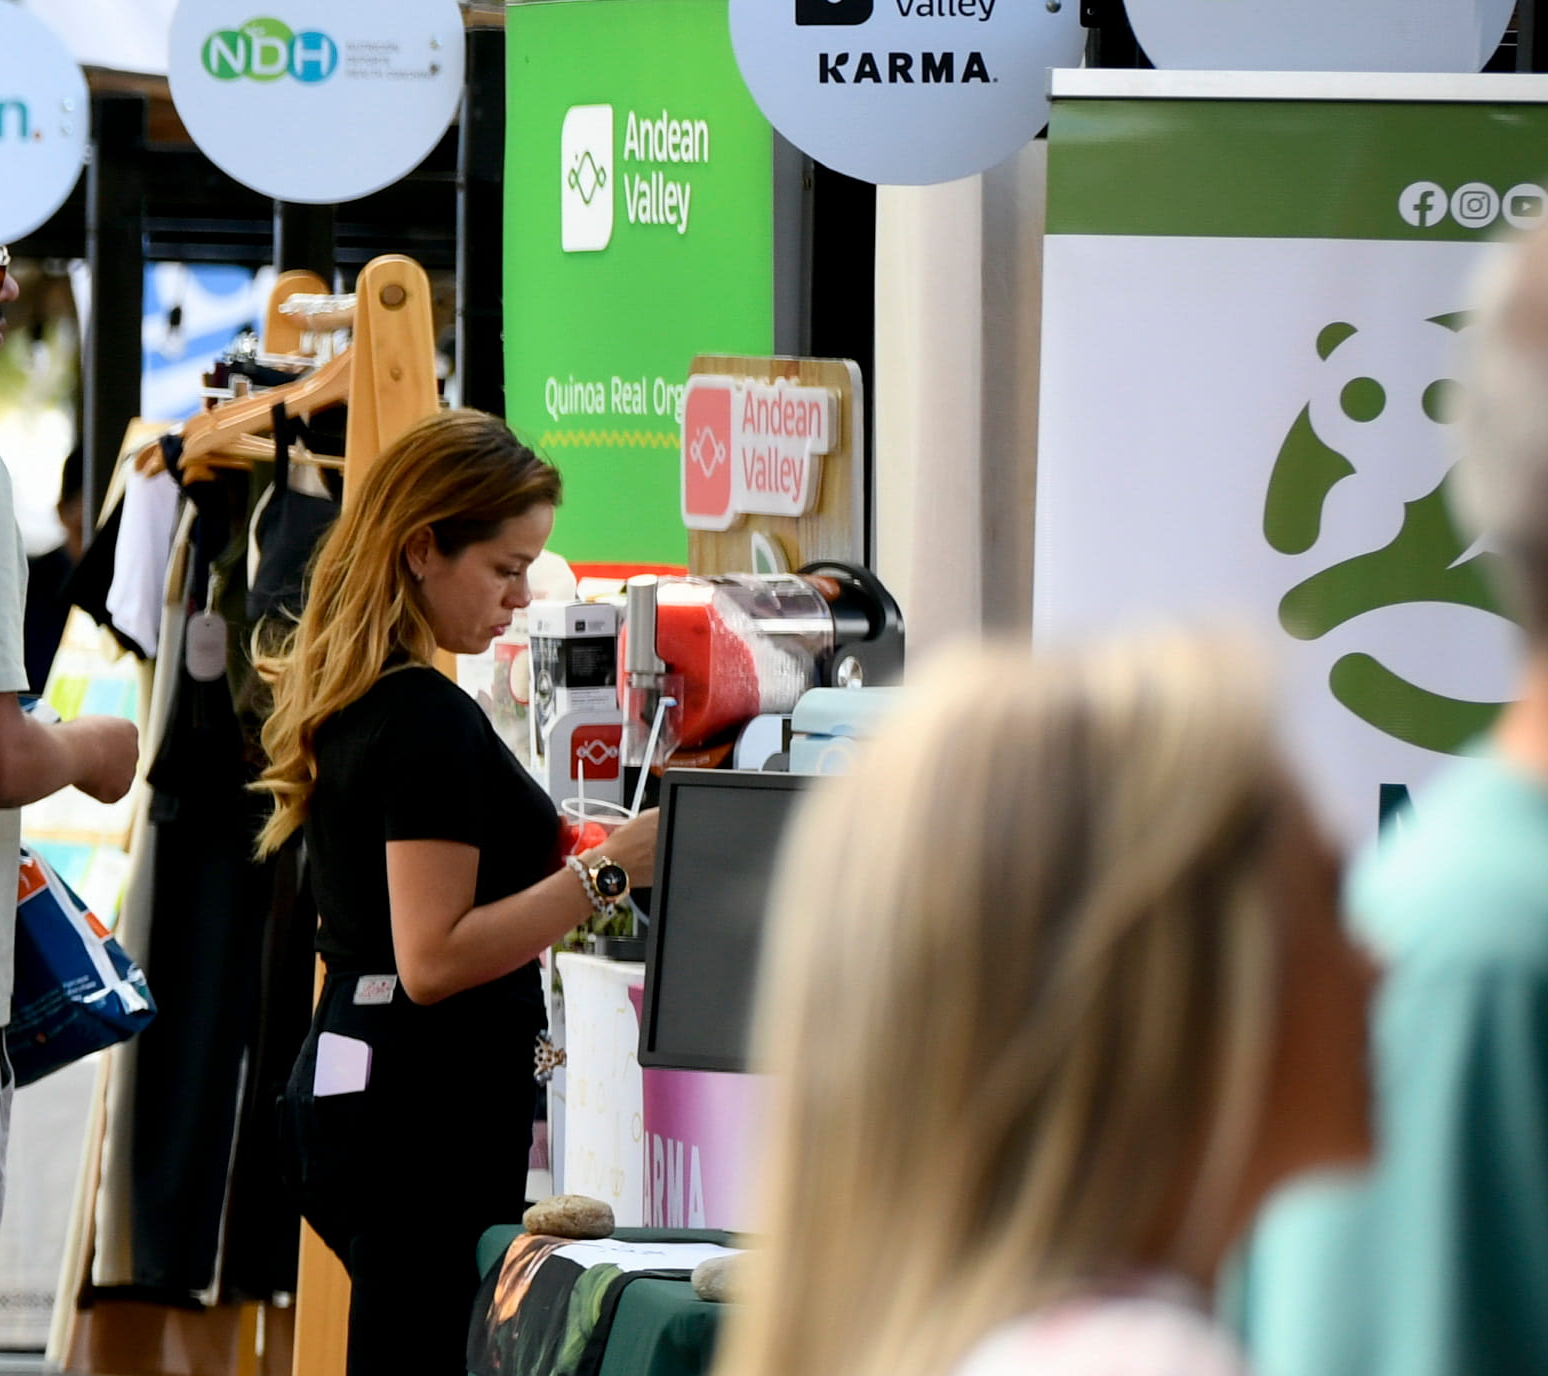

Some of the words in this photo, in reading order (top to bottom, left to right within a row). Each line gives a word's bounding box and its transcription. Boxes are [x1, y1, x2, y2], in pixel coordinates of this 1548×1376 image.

[208, 34, 332, 77] NDH
[622, 108, 710, 164] Andean
[622, 170, 692, 236] Valley
[544, 374, 605, 422] Quinoa
[610, 376, 648, 416] Real
[741, 389, 822, 439] Andean
[741, 446, 805, 503] Valley
